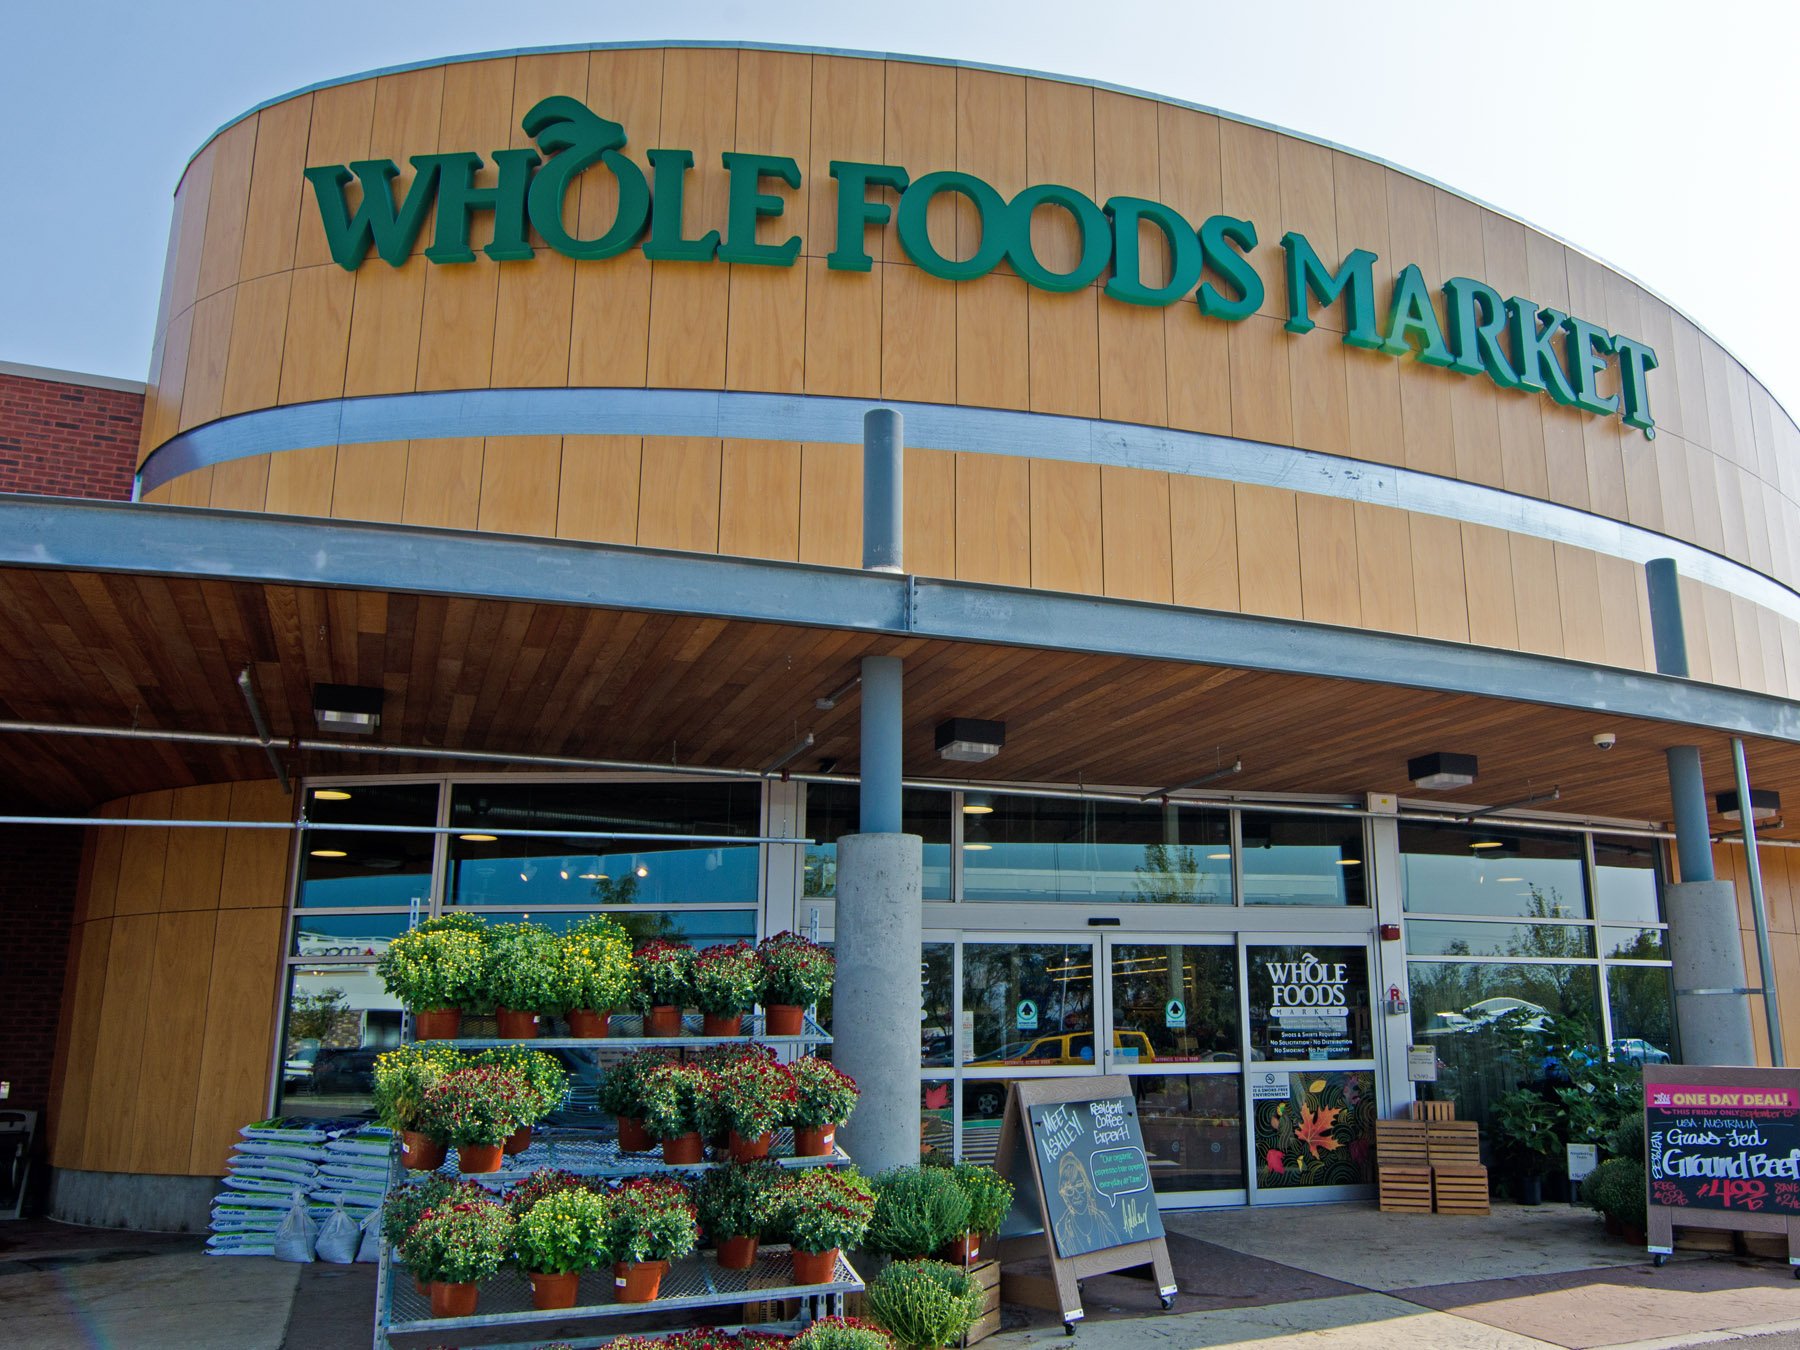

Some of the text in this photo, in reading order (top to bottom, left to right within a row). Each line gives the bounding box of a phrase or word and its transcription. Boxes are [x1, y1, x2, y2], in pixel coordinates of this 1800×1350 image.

[303, 95, 1659, 430] WHOLE FOODS MARKET
[1266, 952, 1348, 984] WHOLE
[1272, 985, 1346, 1006] FOODS
[1089, 1100, 1124, 1116] Resident
[1673, 1093, 1707, 1105] ONE
[1709, 1094, 1739, 1105] DAY
[1743, 1094, 1788, 1106] DEAL!
[1042, 1104, 1068, 1137] MEET
[1095, 1114, 1124, 1129] Coffee
[1676, 1118, 1758, 1129] USA AUSTRALIA
[1041, 1110, 1084, 1163] ASHLEY!
[1662, 1148, 1800, 1180] Ground Beef
[1774, 1182, 1800, 1195] SAVE
